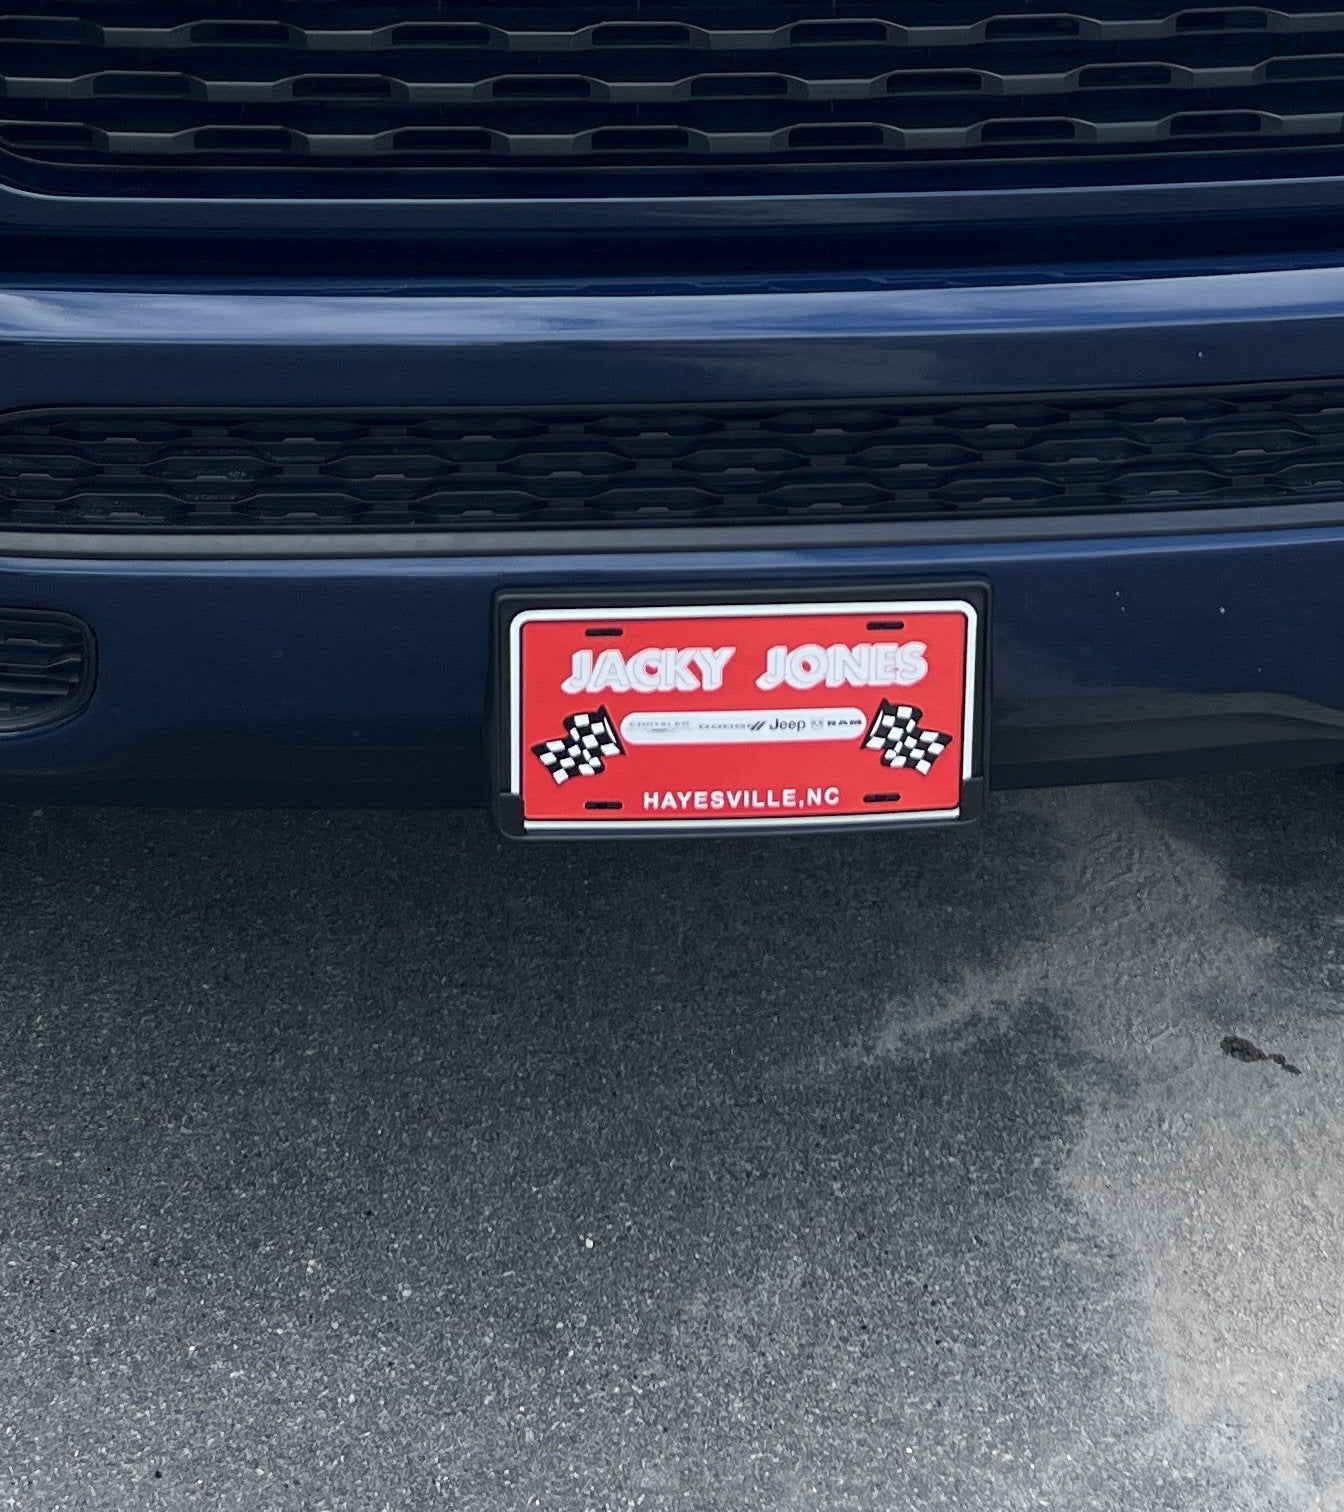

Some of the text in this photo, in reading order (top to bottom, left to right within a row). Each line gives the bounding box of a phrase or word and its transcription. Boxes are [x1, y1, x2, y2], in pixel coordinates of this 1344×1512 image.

[561, 641, 928, 694] JACKY JONES
[769, 718, 806, 731] Jeep
